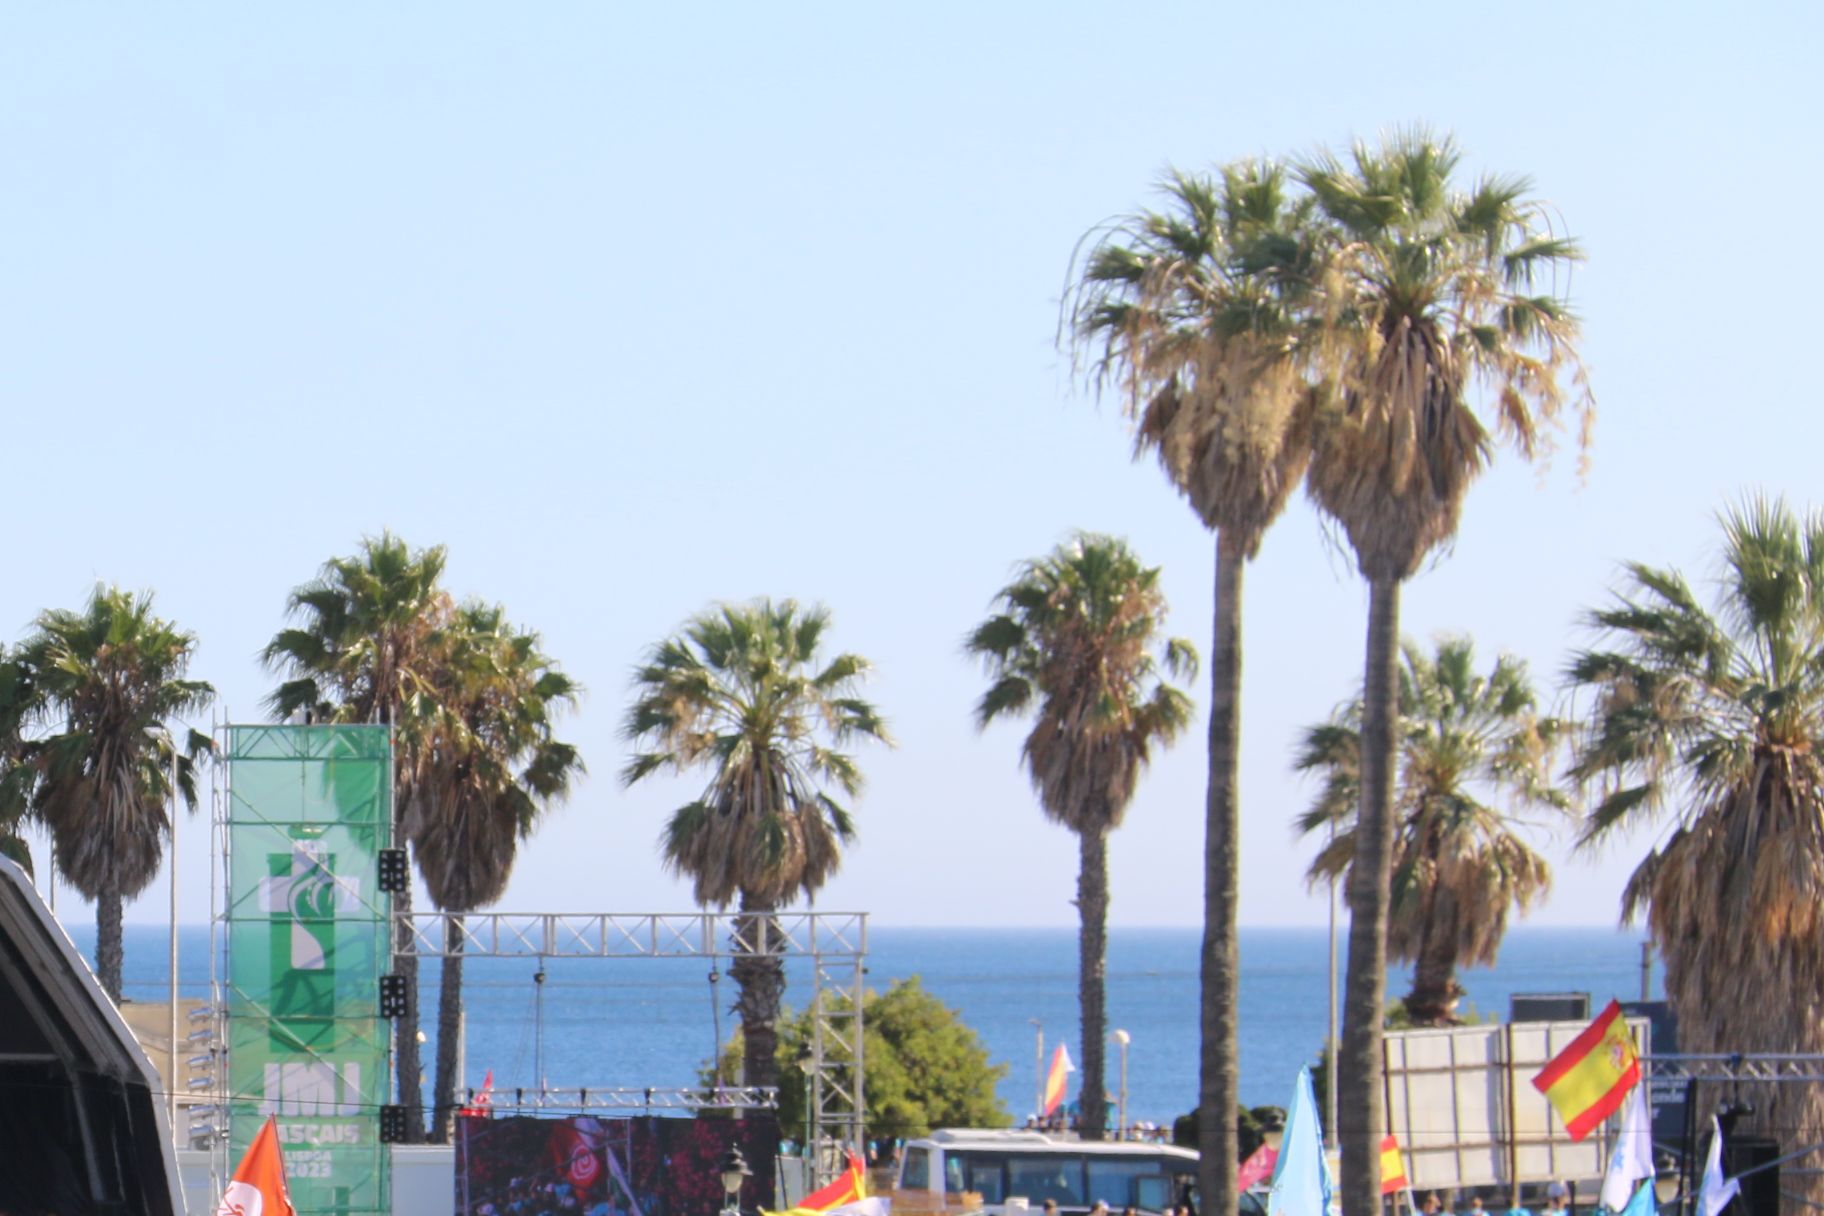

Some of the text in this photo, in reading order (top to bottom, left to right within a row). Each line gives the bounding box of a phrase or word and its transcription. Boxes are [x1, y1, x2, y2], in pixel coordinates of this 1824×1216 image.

[257, 1061, 360, 1117] JMJ
[262, 1123, 360, 1144] ASCAIS
[286, 1161, 333, 1178] 2023
